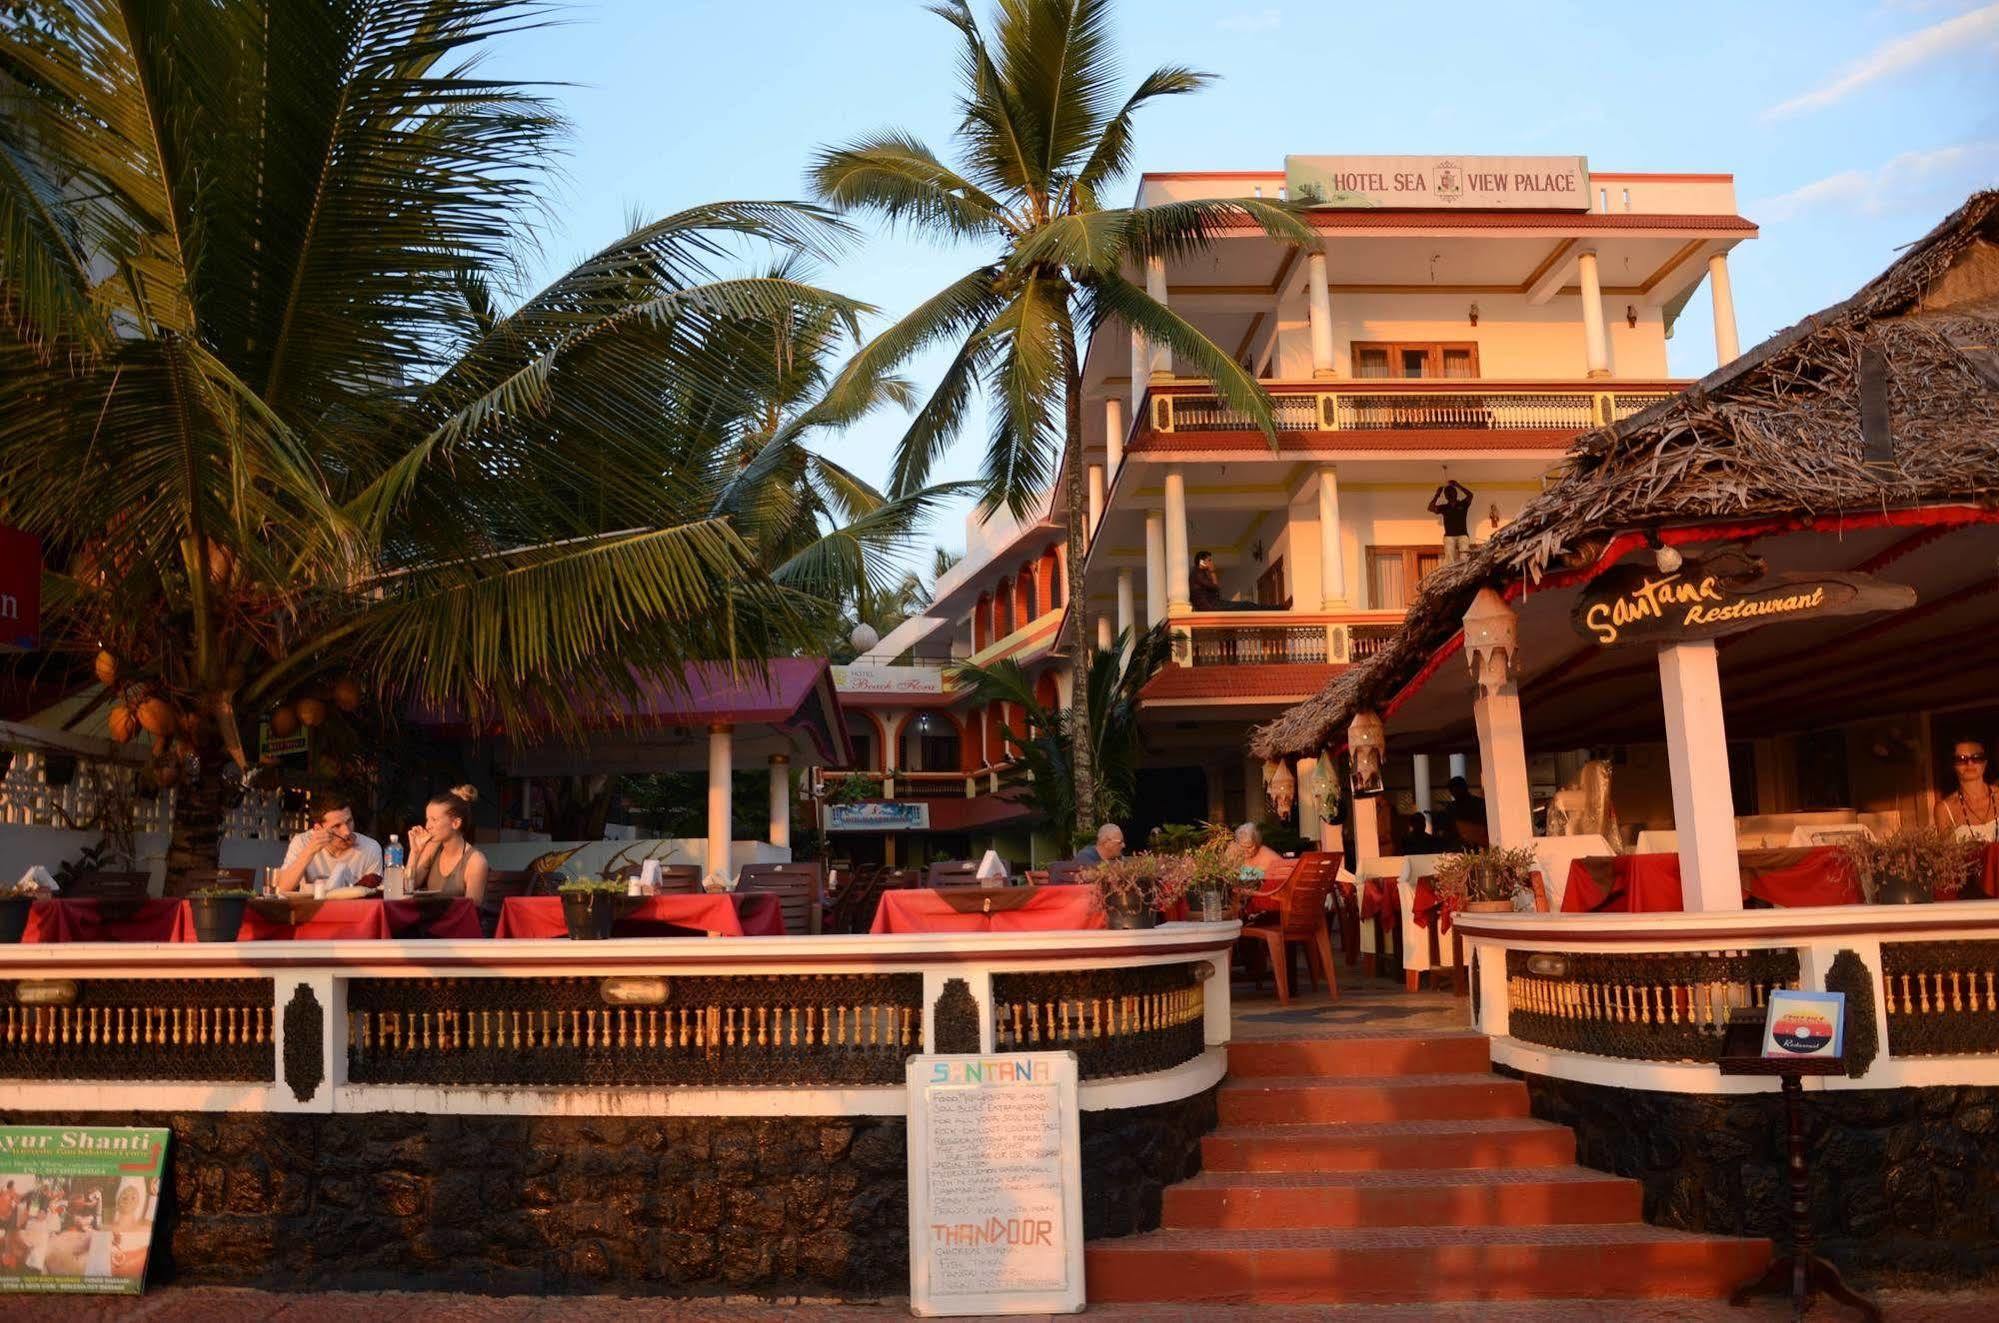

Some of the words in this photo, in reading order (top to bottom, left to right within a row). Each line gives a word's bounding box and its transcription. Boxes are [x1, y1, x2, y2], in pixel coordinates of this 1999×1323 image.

[1333, 173, 1389, 192] HOTEL
[1394, 173, 1427, 192] SEA
[1467, 173, 1508, 192] VIEW
[1514, 173, 1576, 192] PALACE
[1587, 574, 1722, 643] Santana
[1683, 587, 1823, 625] Restaurant
[930, 1060, 1050, 1082] SANTANA
[60, 1131, 150, 1150] Shanti
[930, 1217, 1052, 1247] THANDOOR
